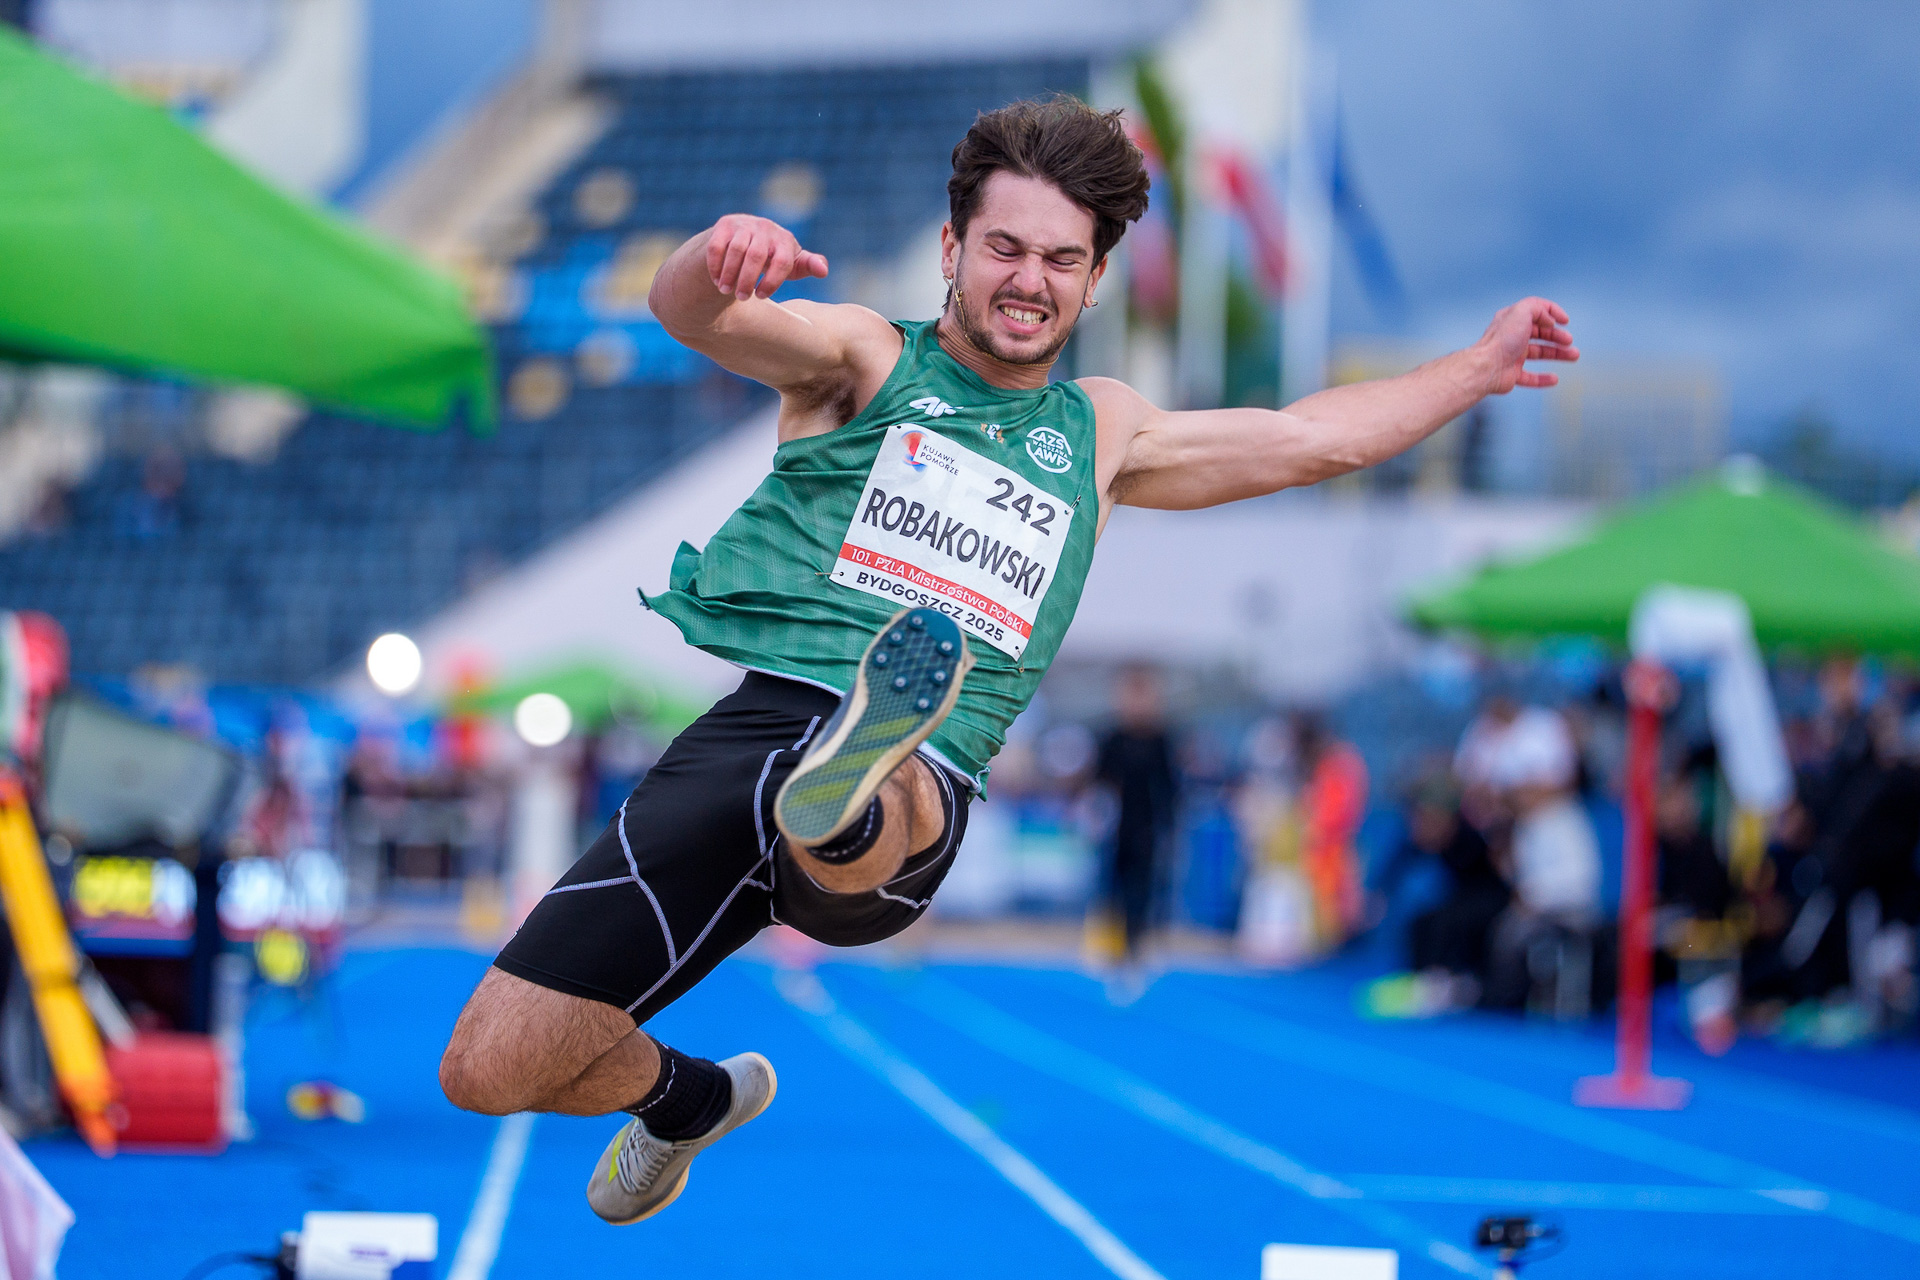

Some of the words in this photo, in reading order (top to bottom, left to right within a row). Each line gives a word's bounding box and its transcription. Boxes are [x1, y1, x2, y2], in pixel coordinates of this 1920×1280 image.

[1032, 439, 1068, 459] WARSZAWA
[1038, 431, 1065, 450] AZS
[919, 451, 960, 476] POMORZE
[922, 444, 955, 465] KUJAWY
[1033, 446, 1066, 466] AWF
[986, 477, 1056, 537] 242
[861, 487, 1046, 600] ROBAKOWSKI
[851, 548, 872, 566] 101.
[874, 555, 905, 577] PZLA
[907, 569, 988, 610] Mistrzostwa
[988, 601, 1024, 632] Polski
[856, 571, 963, 620] BYDGOSZCZ
[964, 612, 1005, 642] 2025
